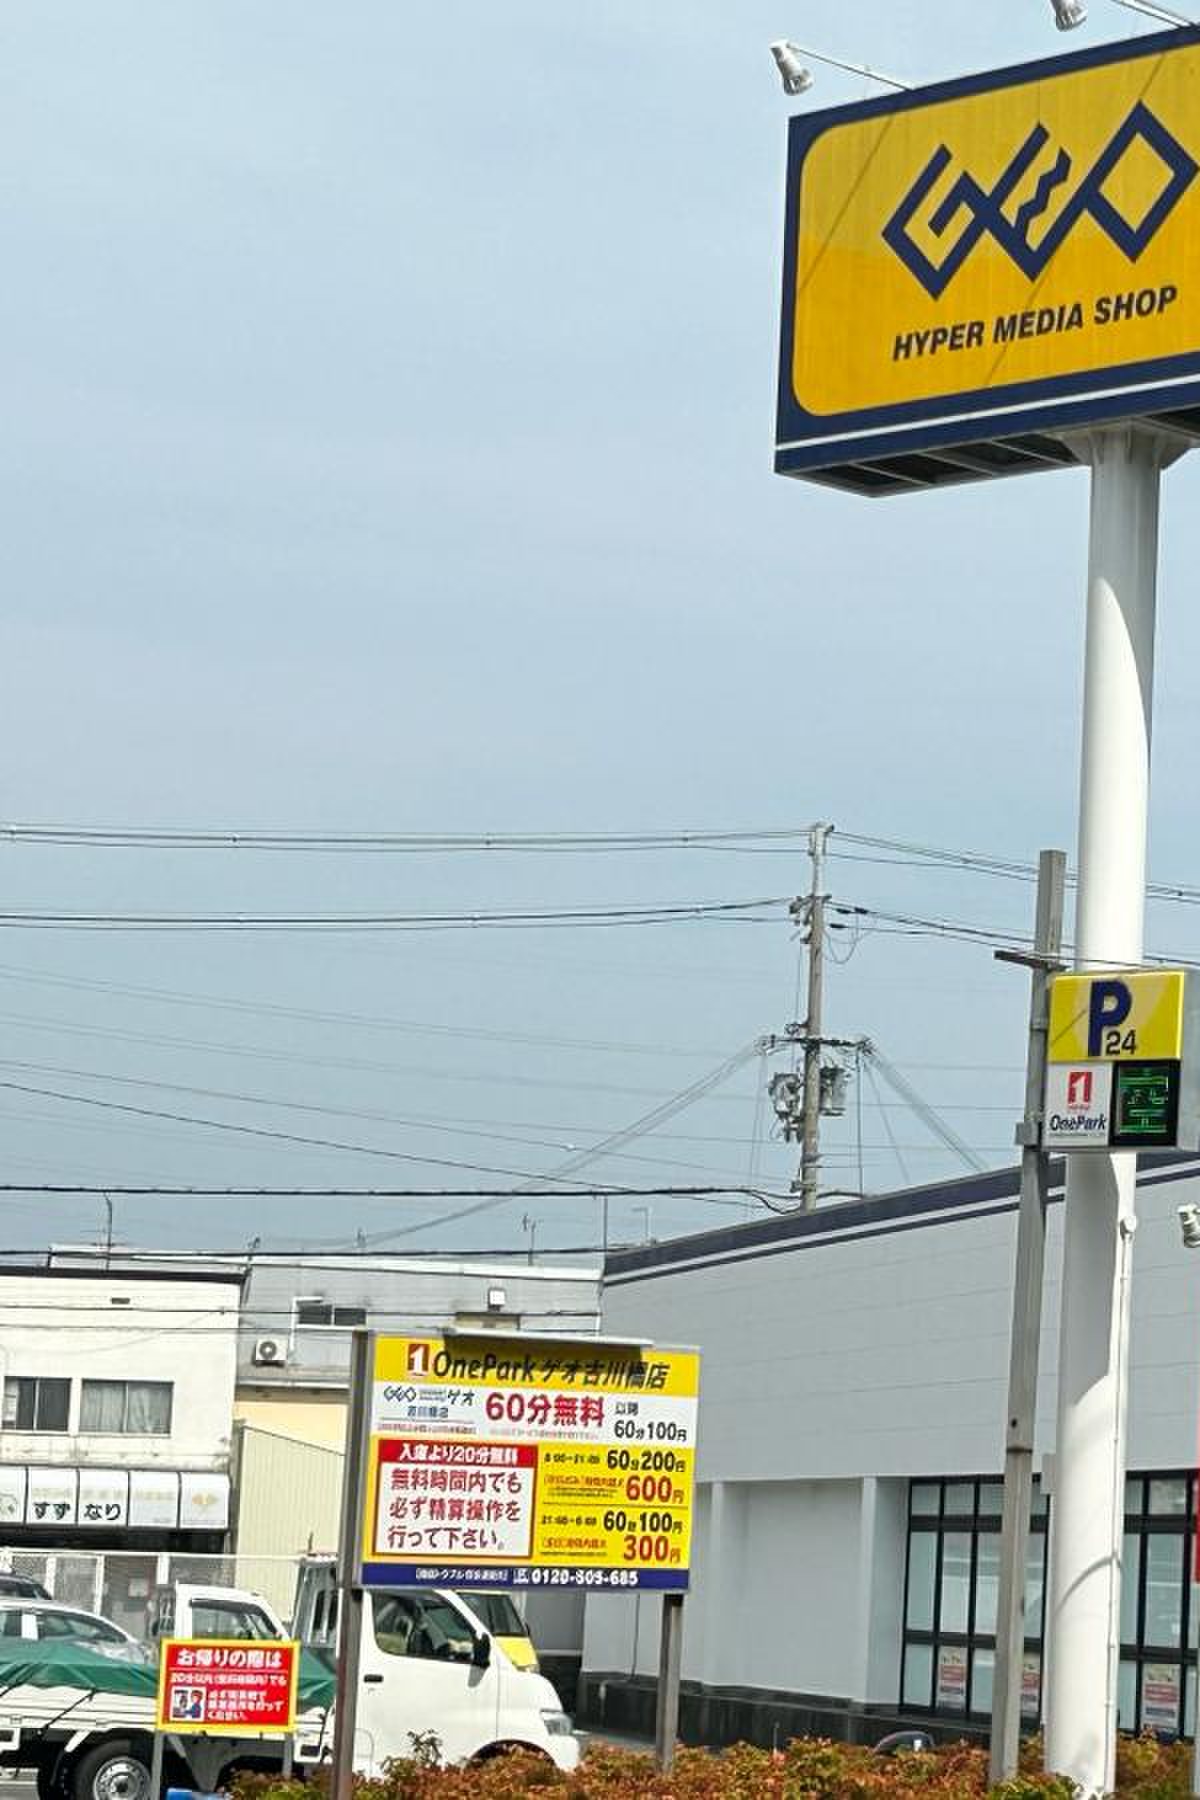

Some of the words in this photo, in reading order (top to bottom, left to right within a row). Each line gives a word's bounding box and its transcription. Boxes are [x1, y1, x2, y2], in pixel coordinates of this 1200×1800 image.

[892, 320, 983, 361] HYPER
[993, 302, 1084, 343] MEDIA
[1093, 284, 1178, 325] SHOP
[1087, 979, 1133, 1057] P
[1105, 1029, 1138, 1056] 24
[1049, 1114, 1107, 1132] OnePark
[433, 1350, 536, 1382] OnePark
[486, 1391, 605, 1428] 60分無料
[614, 1420, 687, 1442] 60分100円
[391, 1468, 523, 1494] 無料時間内でも
[626, 1474, 685, 1505] 600円
[33, 1502, 121, 1521] すずなり
[389, 1497, 521, 1522] 必ず精算操作を
[388, 1525, 505, 1550] 行って下さい。
[623, 1534, 682, 1564] 300円
